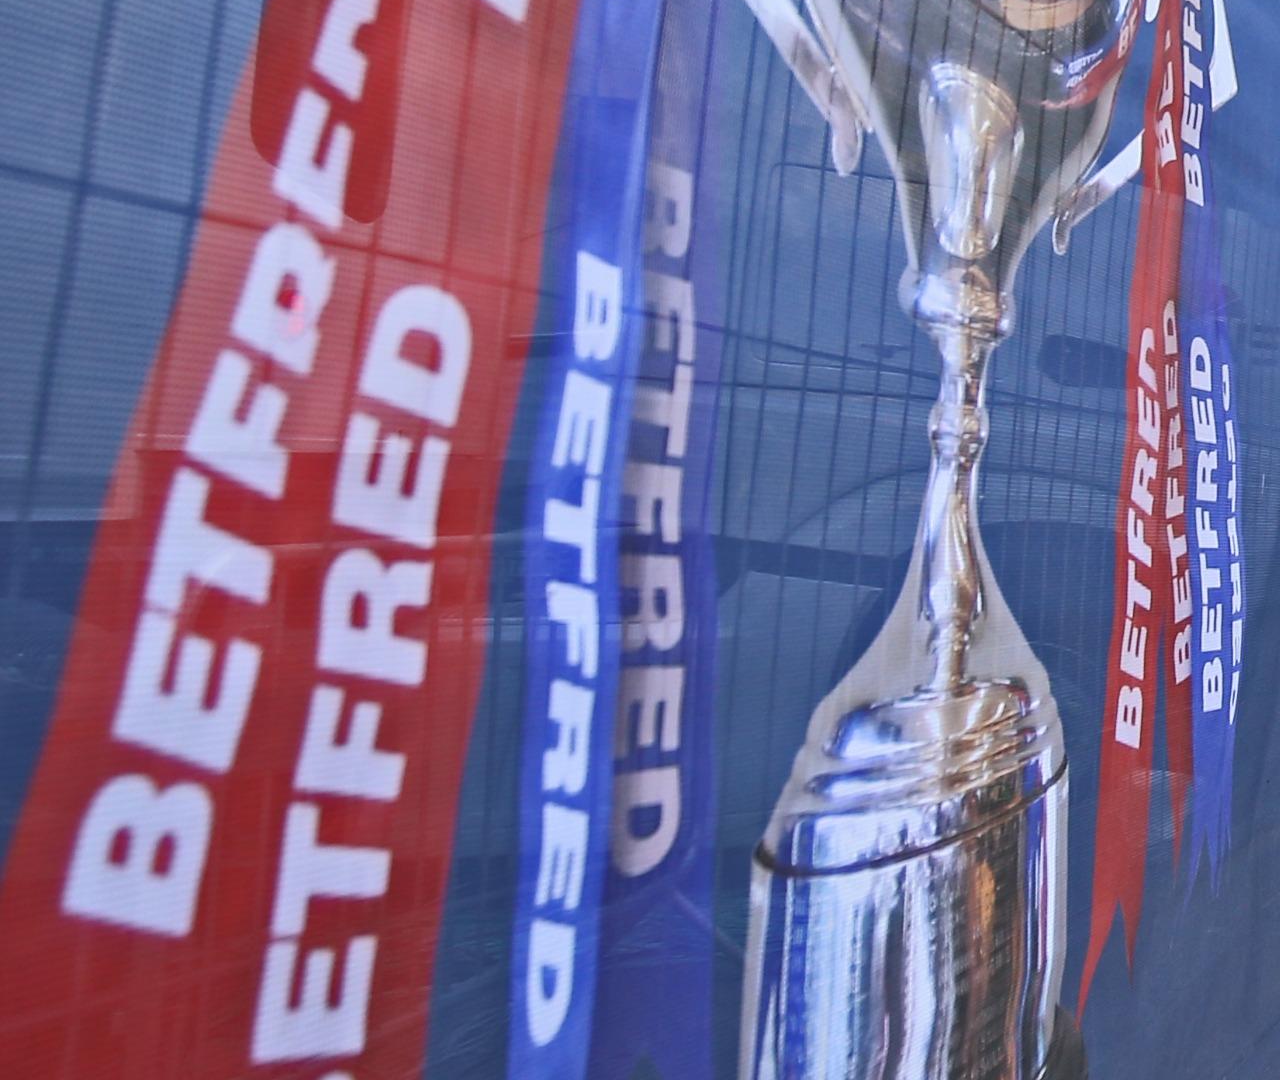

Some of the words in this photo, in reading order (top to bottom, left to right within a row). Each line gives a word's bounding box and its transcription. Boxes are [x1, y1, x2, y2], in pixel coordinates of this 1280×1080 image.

[250, 285, 474, 1080] ETFRED
[526, 251, 624, 1048] BETFRED
[611, 160, 697, 879] BETFRED
[1162, 299, 1193, 686] BETFRED
[1190, 336, 1224, 713] BETFRED
